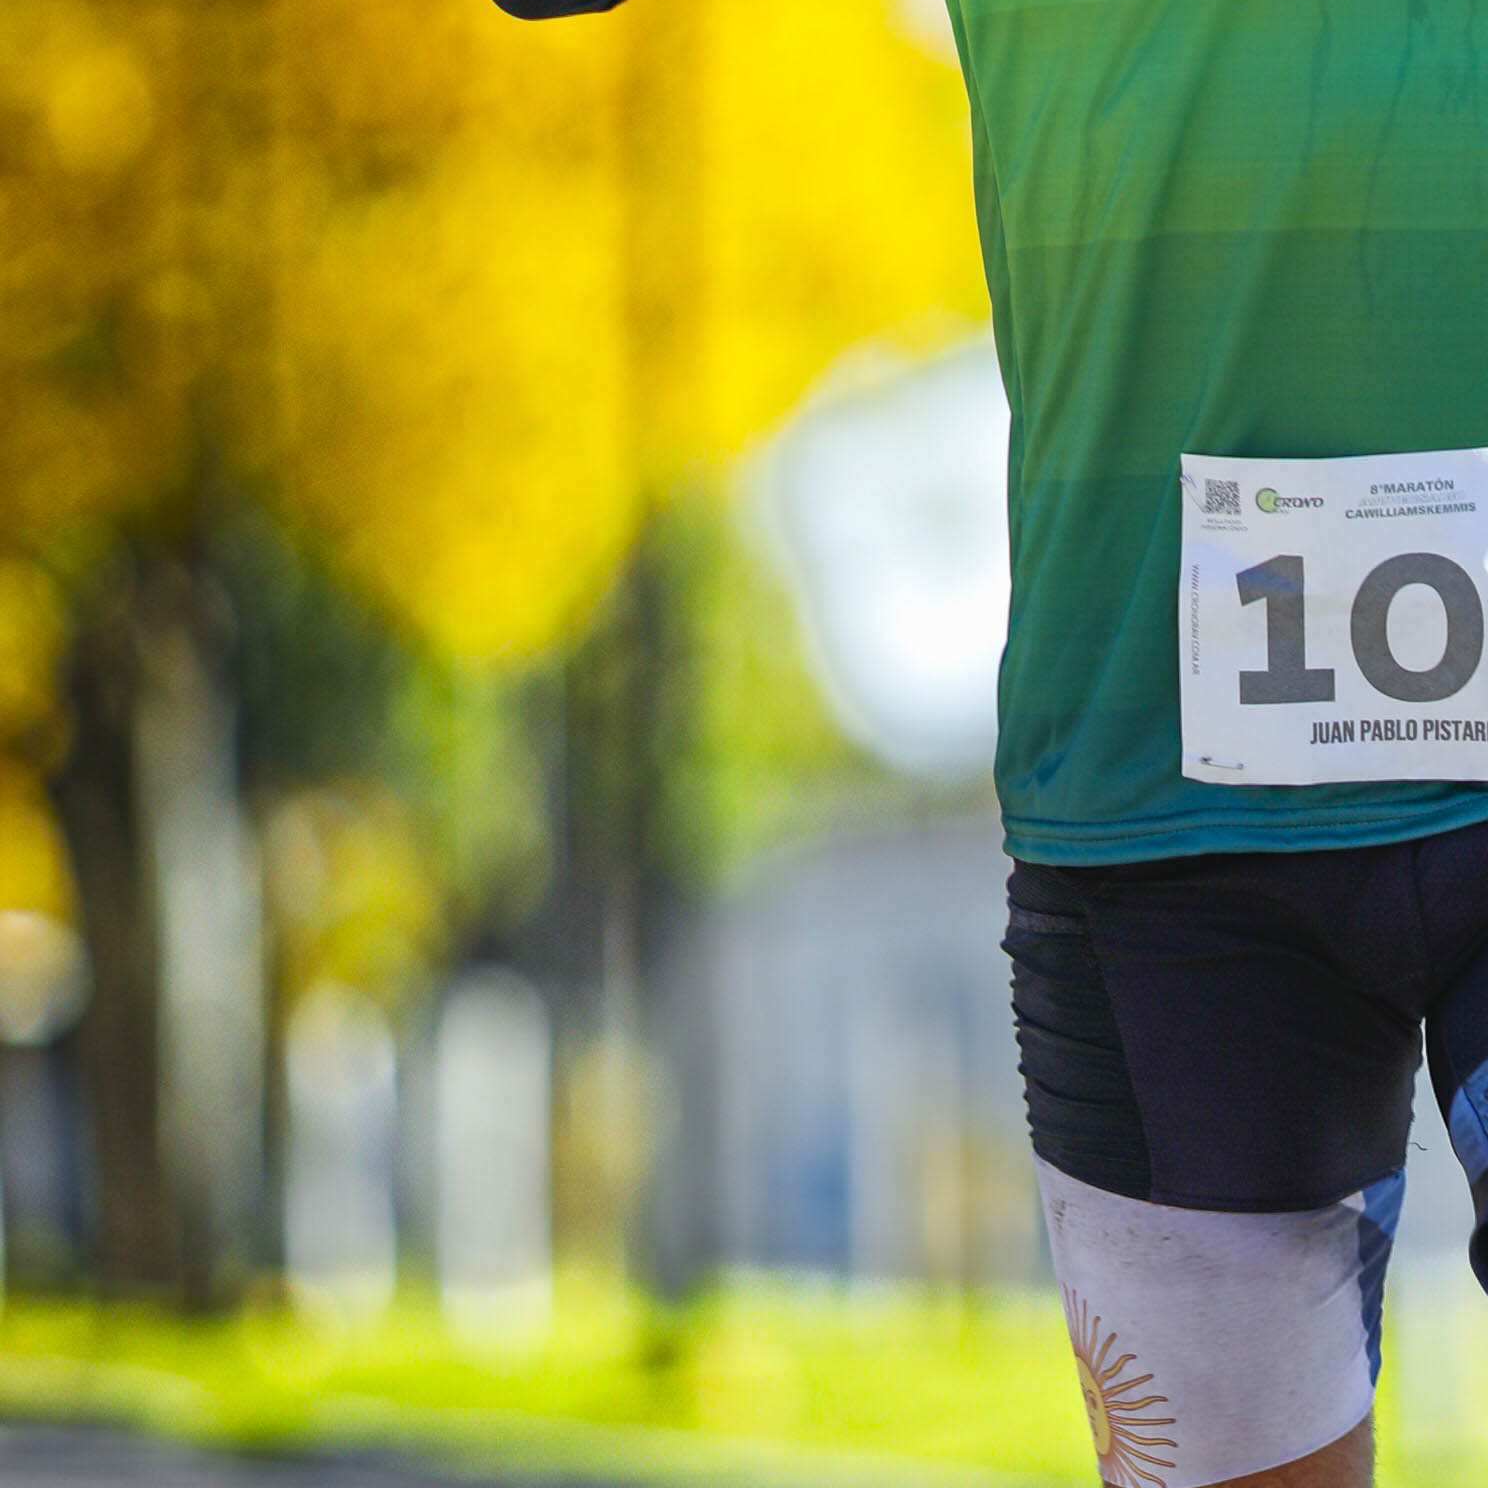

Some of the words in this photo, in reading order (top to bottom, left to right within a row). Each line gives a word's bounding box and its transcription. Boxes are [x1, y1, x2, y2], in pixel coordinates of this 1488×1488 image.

[1345, 502, 1476, 520] CAWILLIAMSKEMMIS
[1310, 720, 1355, 744] JUAN
[1360, 719, 1418, 742] PABLO
